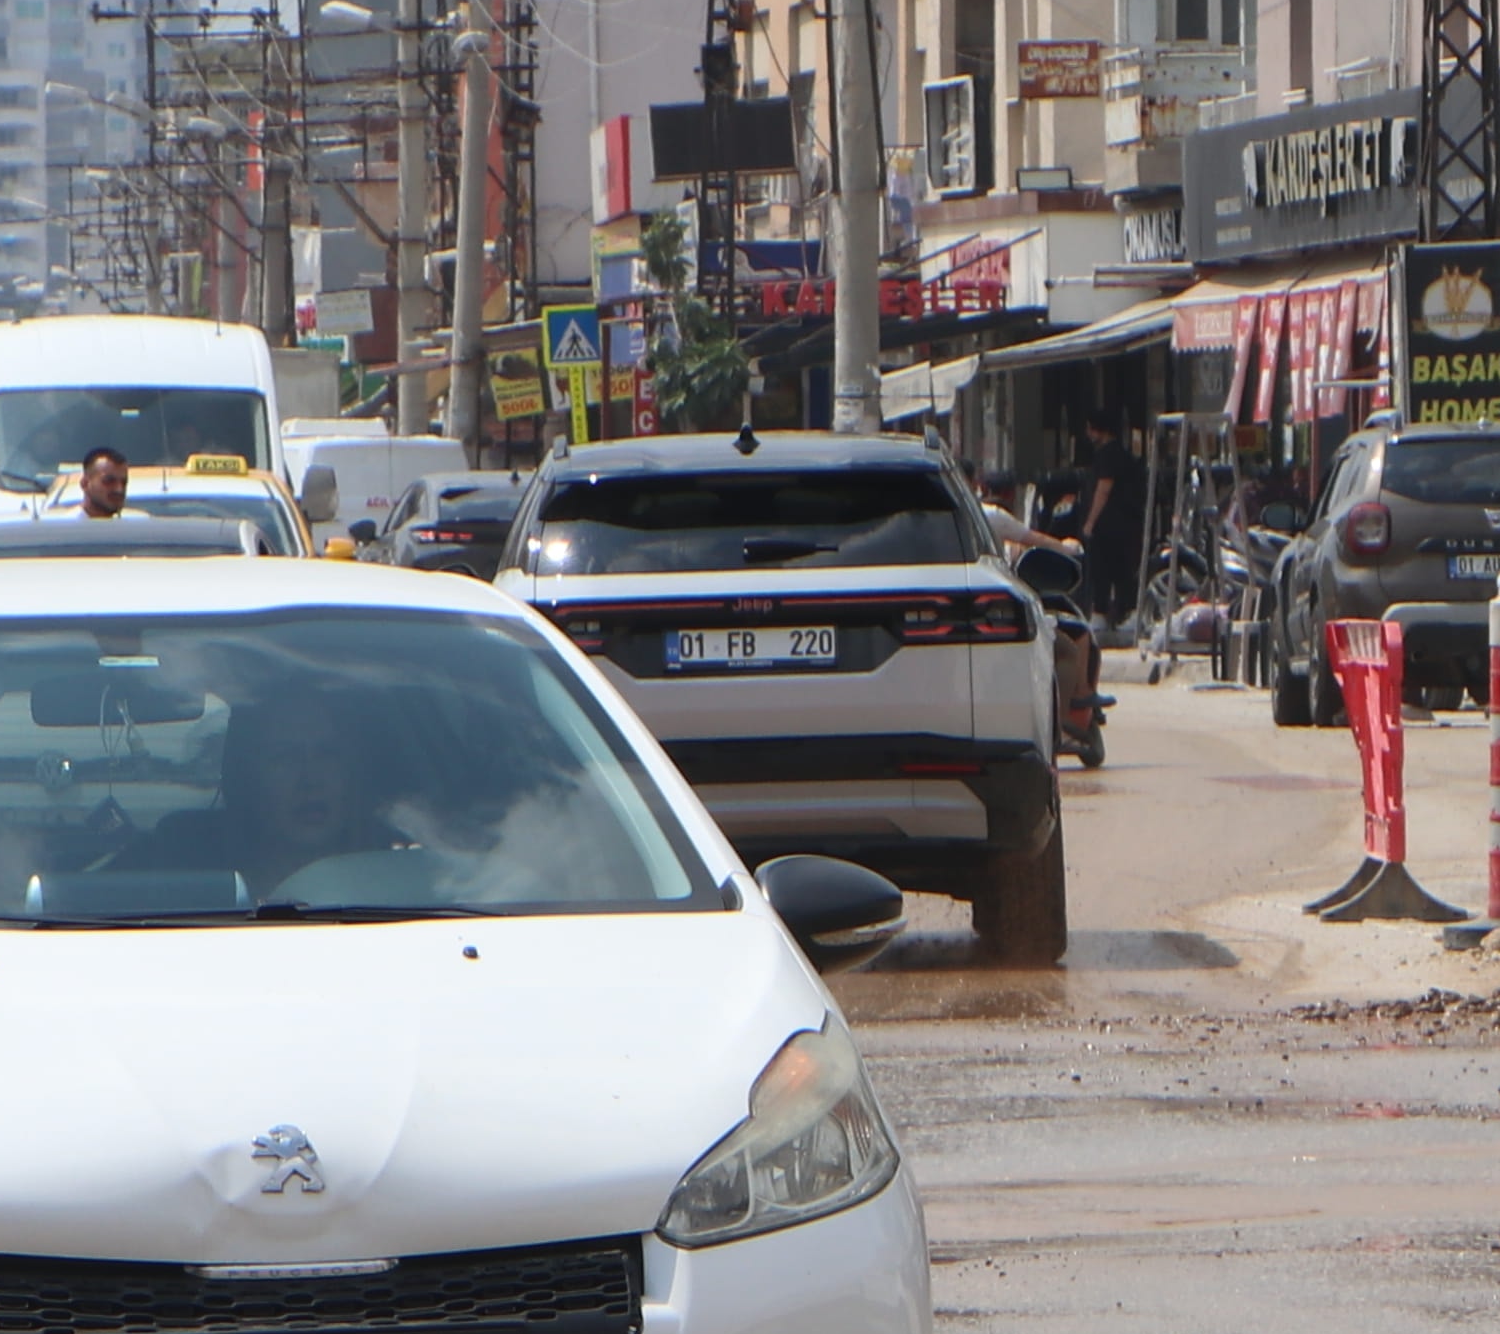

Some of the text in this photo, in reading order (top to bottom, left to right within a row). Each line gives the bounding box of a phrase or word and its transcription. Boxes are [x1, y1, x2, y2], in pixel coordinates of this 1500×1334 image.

[1265, 119, 1383, 218] KARDEŞLER ET
[732, 598, 773, 613] Jeep
[680, 633, 704, 659] 01
[728, 631, 756, 657] FB
[790, 629, 833, 656] 220
[227, 1266, 364, 1278] PEUGEOT
